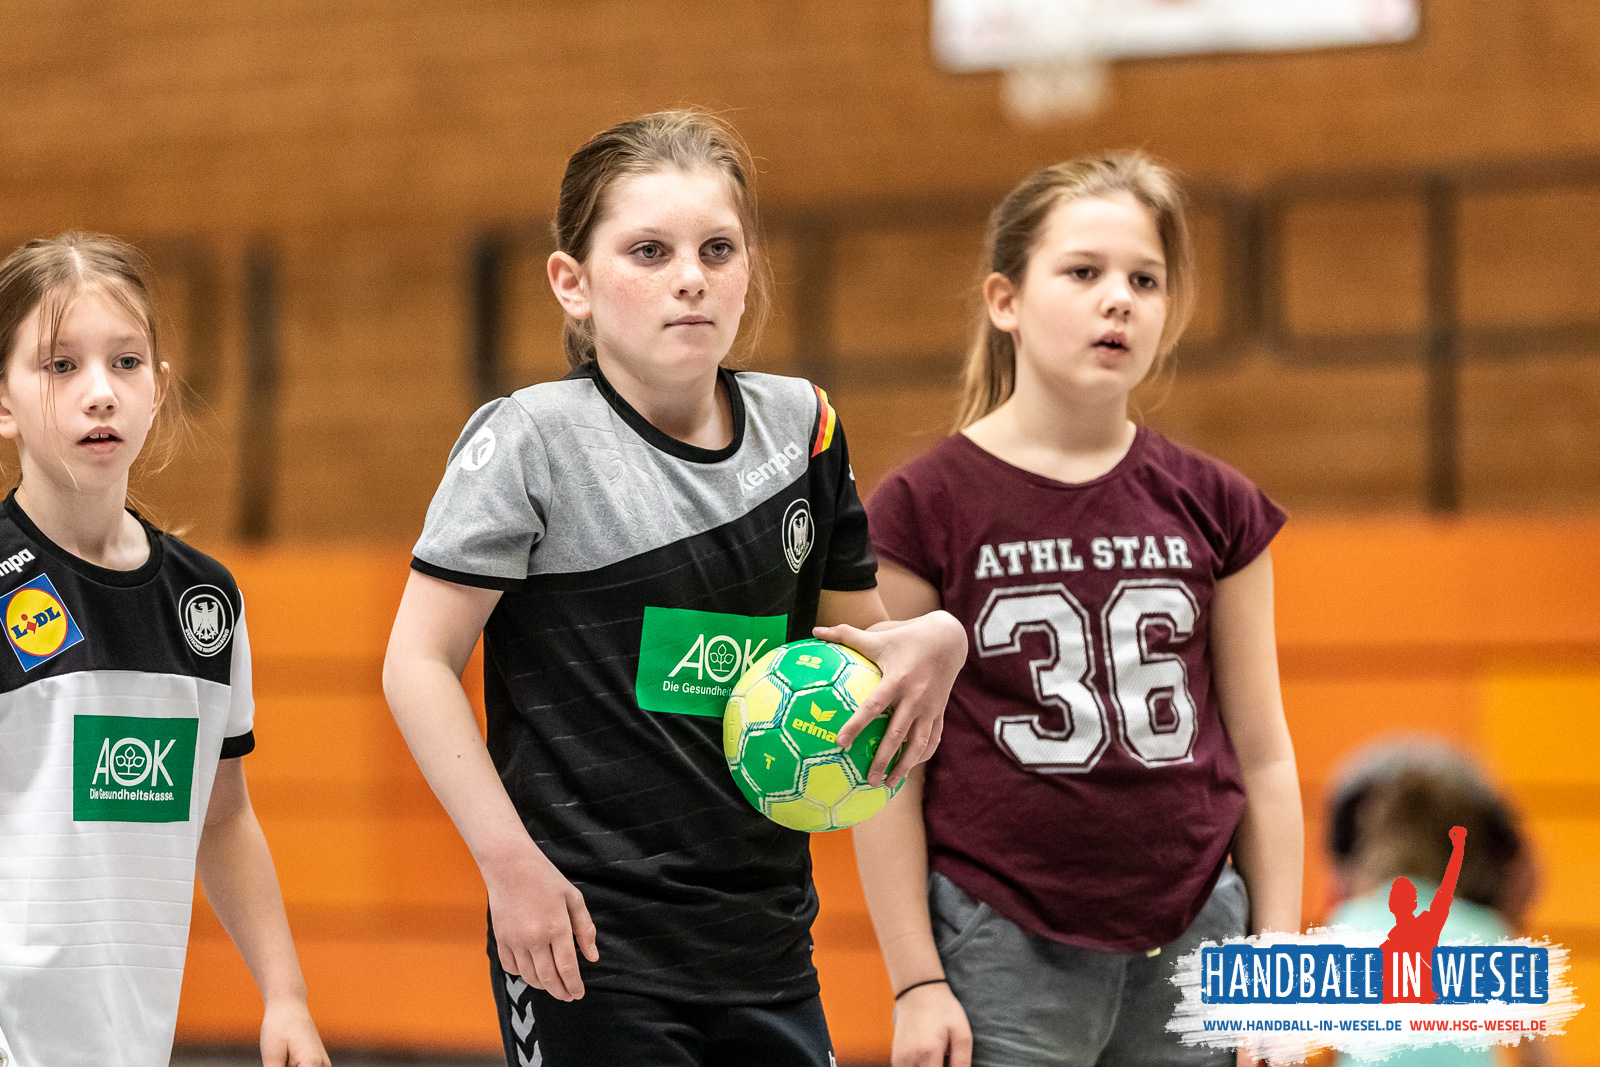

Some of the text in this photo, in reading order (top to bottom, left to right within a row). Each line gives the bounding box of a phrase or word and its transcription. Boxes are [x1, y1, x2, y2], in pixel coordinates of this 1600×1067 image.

[735, 441, 804, 496] Kempa
[975, 535, 1193, 580] ATHL STAR
[667, 633, 769, 683] AOK
[973, 578, 1201, 774] 36
[662, 680, 732, 697] Die Gesundheit
[792, 718, 838, 744] erima
[91, 737, 177, 787] AOK
[89, 788, 99, 800] Die
